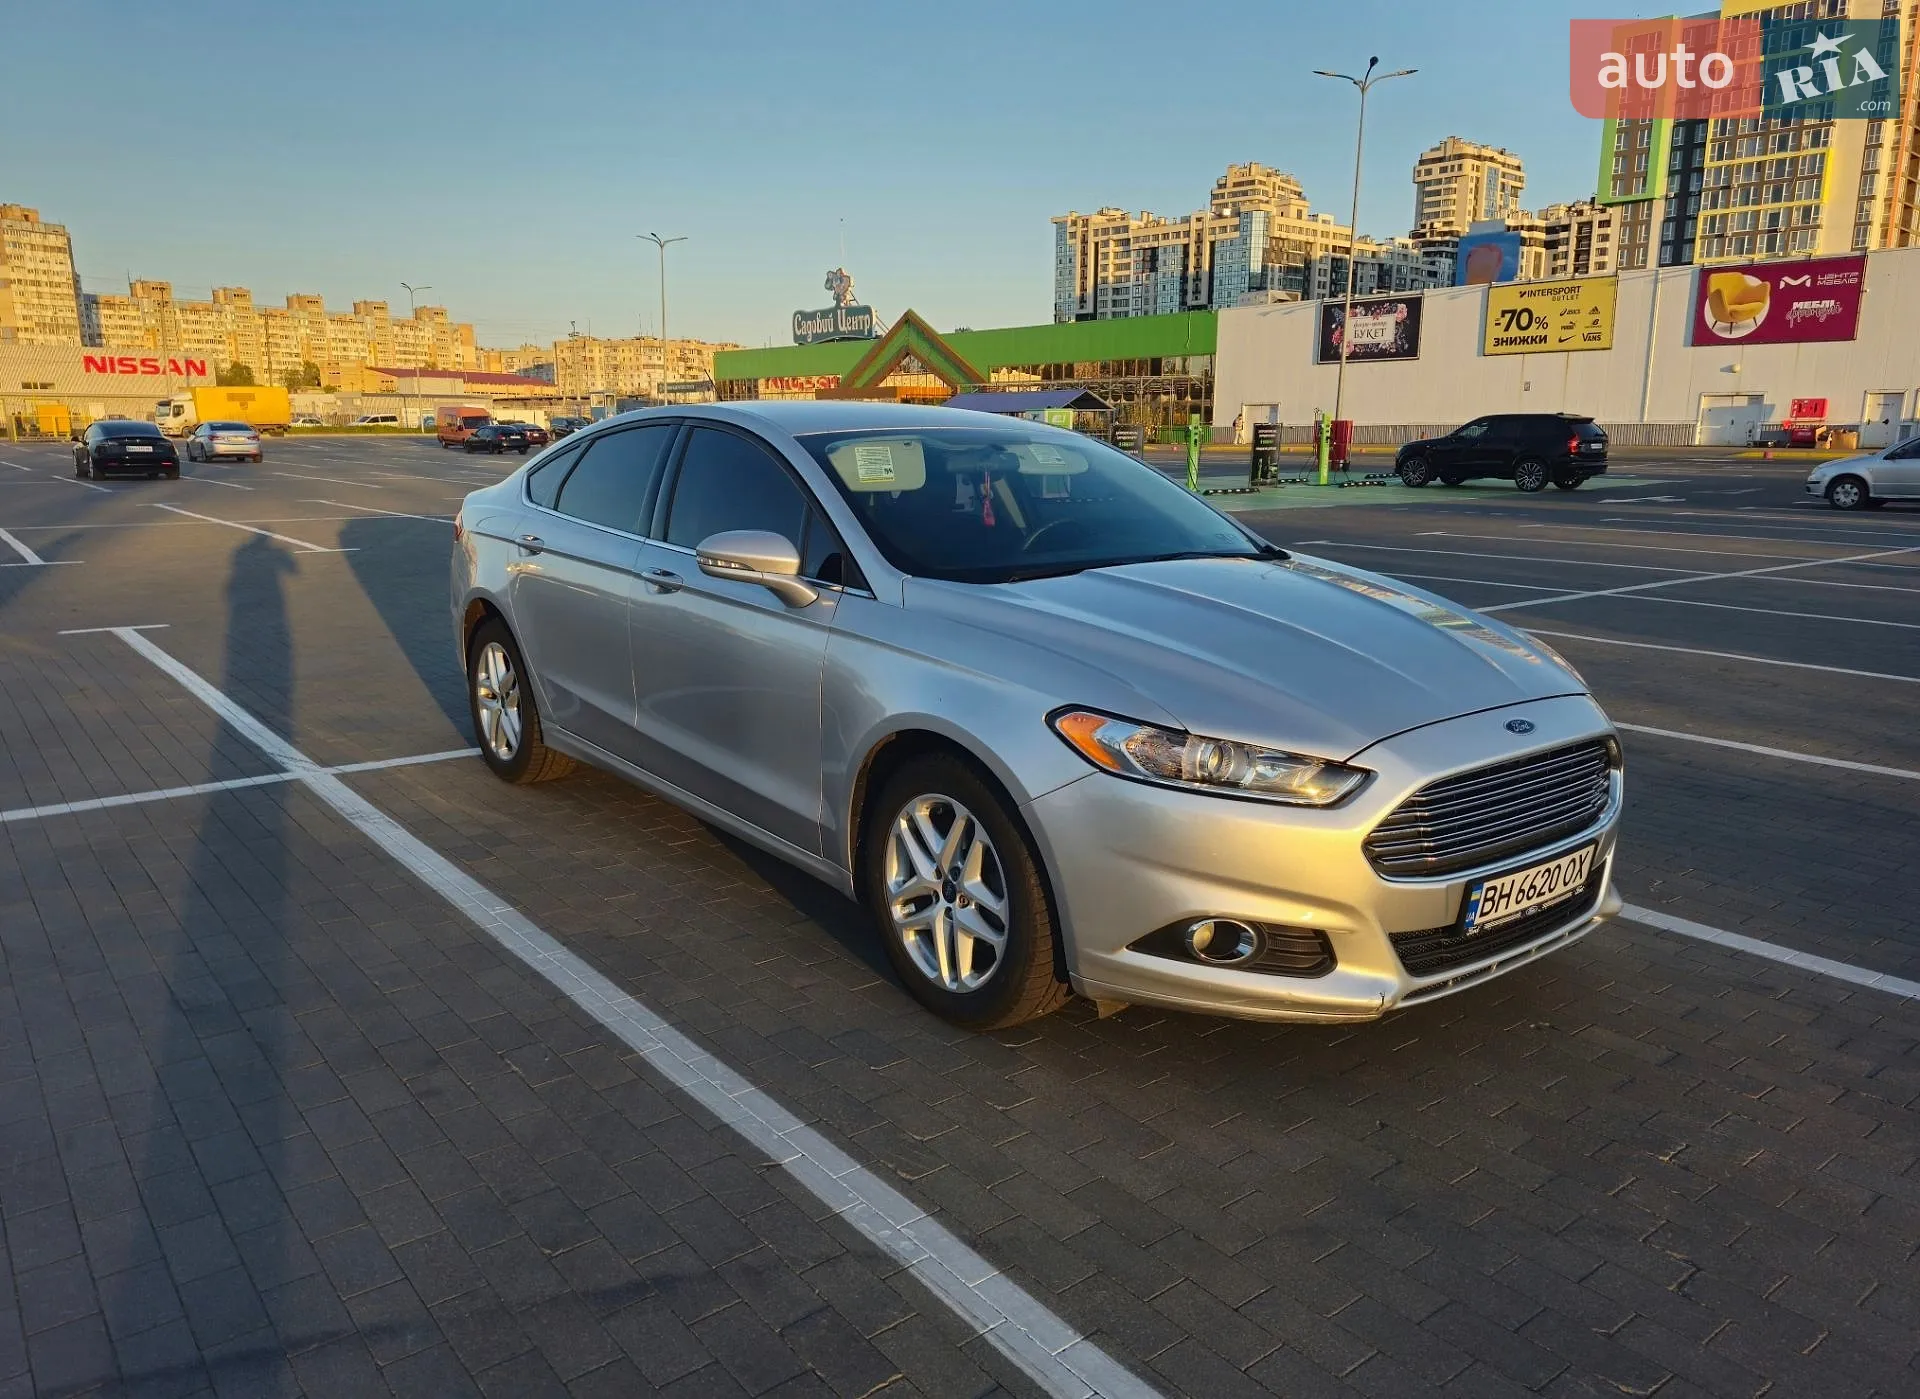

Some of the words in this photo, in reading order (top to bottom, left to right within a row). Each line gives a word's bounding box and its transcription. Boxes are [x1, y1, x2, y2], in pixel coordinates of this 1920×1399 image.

[1527, 286, 1582, 298] INTERSPORT
[1552, 294, 1579, 302] OUTLET
[795, 312, 834, 342] Садовий
[837, 308, 871, 336] Центр
[1354, 328, 1387, 340] БУКЕТ
[83, 355, 207, 377] NISSAN
[1479, 879, 1515, 918] BH
[1516, 863, 1561, 905] 6620
[1563, 850, 1590, 887] OX
